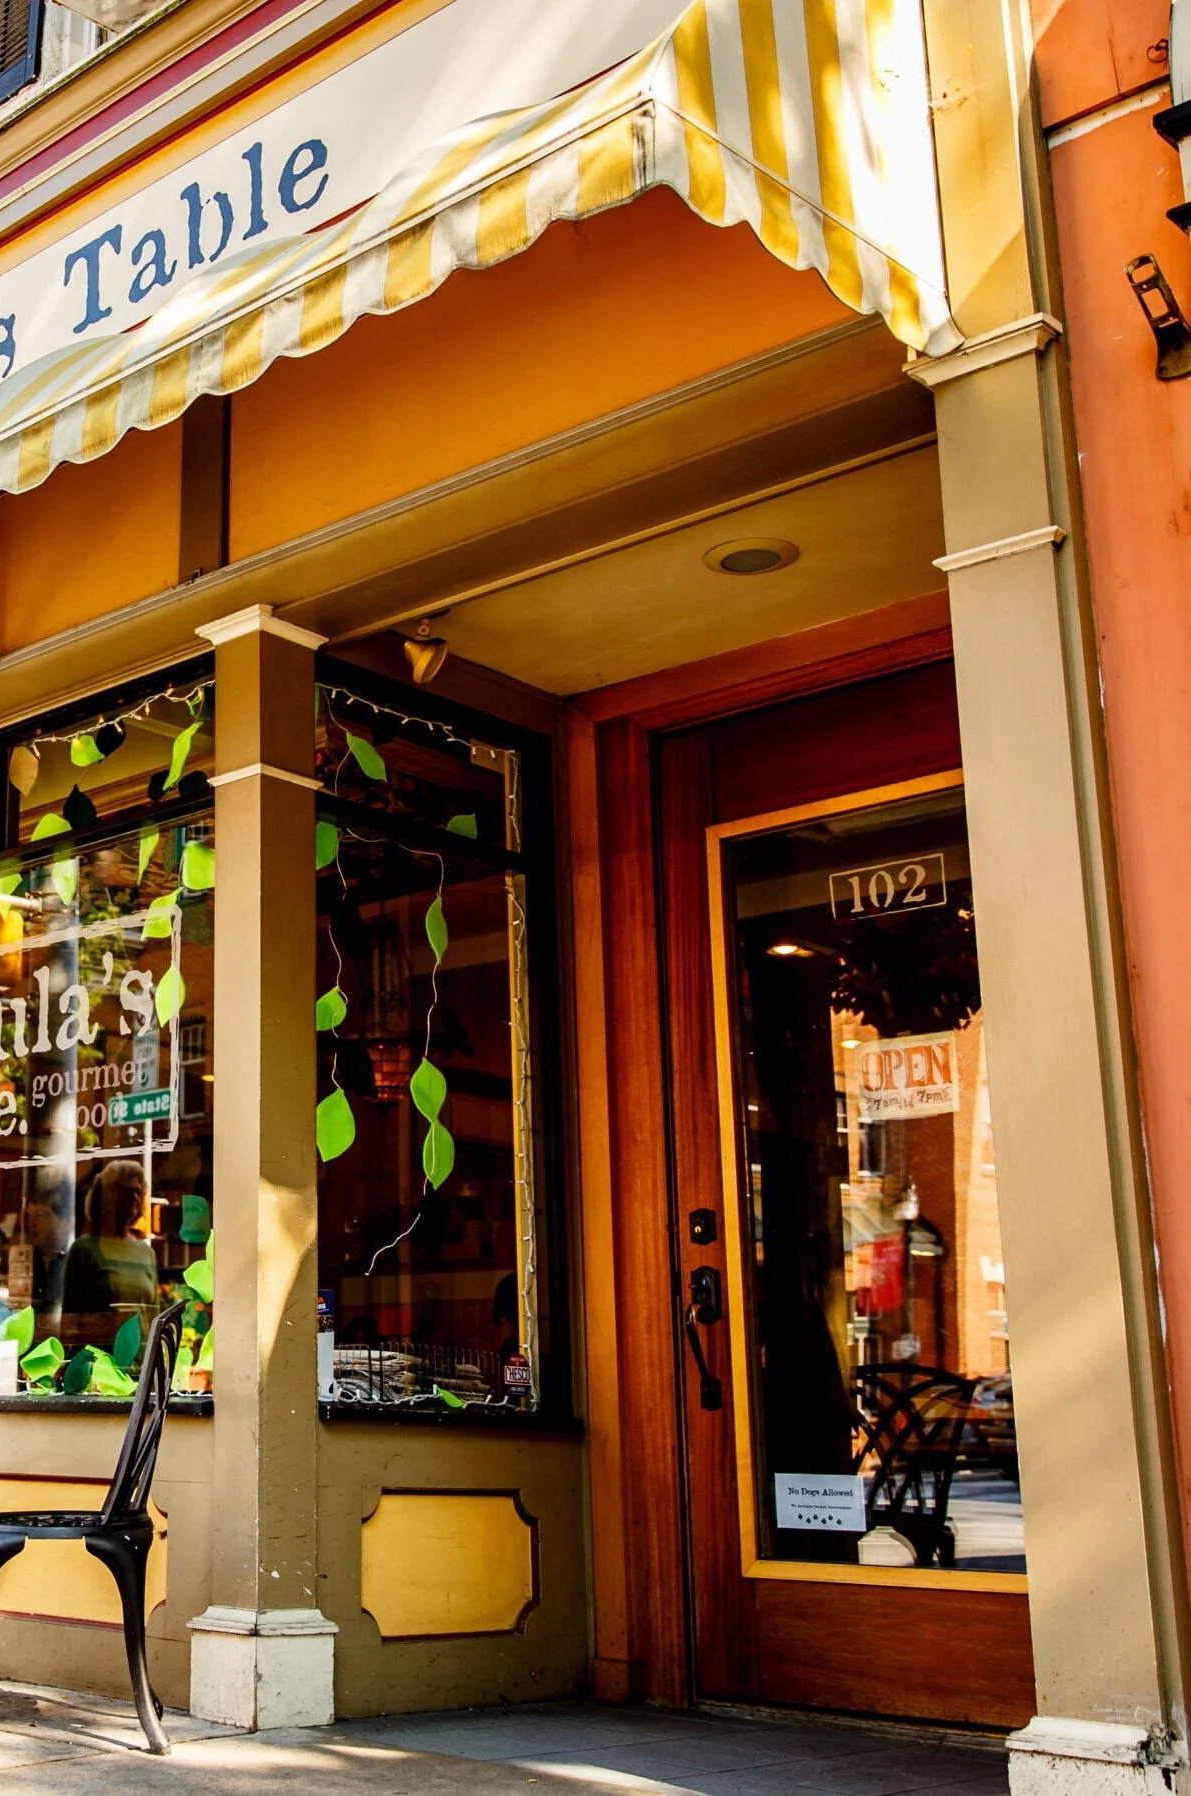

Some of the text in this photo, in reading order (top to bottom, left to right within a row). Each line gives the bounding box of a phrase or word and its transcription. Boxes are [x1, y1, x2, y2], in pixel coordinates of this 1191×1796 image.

[63, 137, 329, 335] Table
[847, 864, 927, 914] 102
[31, 1051, 148, 1108] gourmet
[862, 1042, 953, 1092] OPEN
[917, 1090, 942, 1103] 7pm
[788, 1487, 853, 1498] No Dogs Allowed
